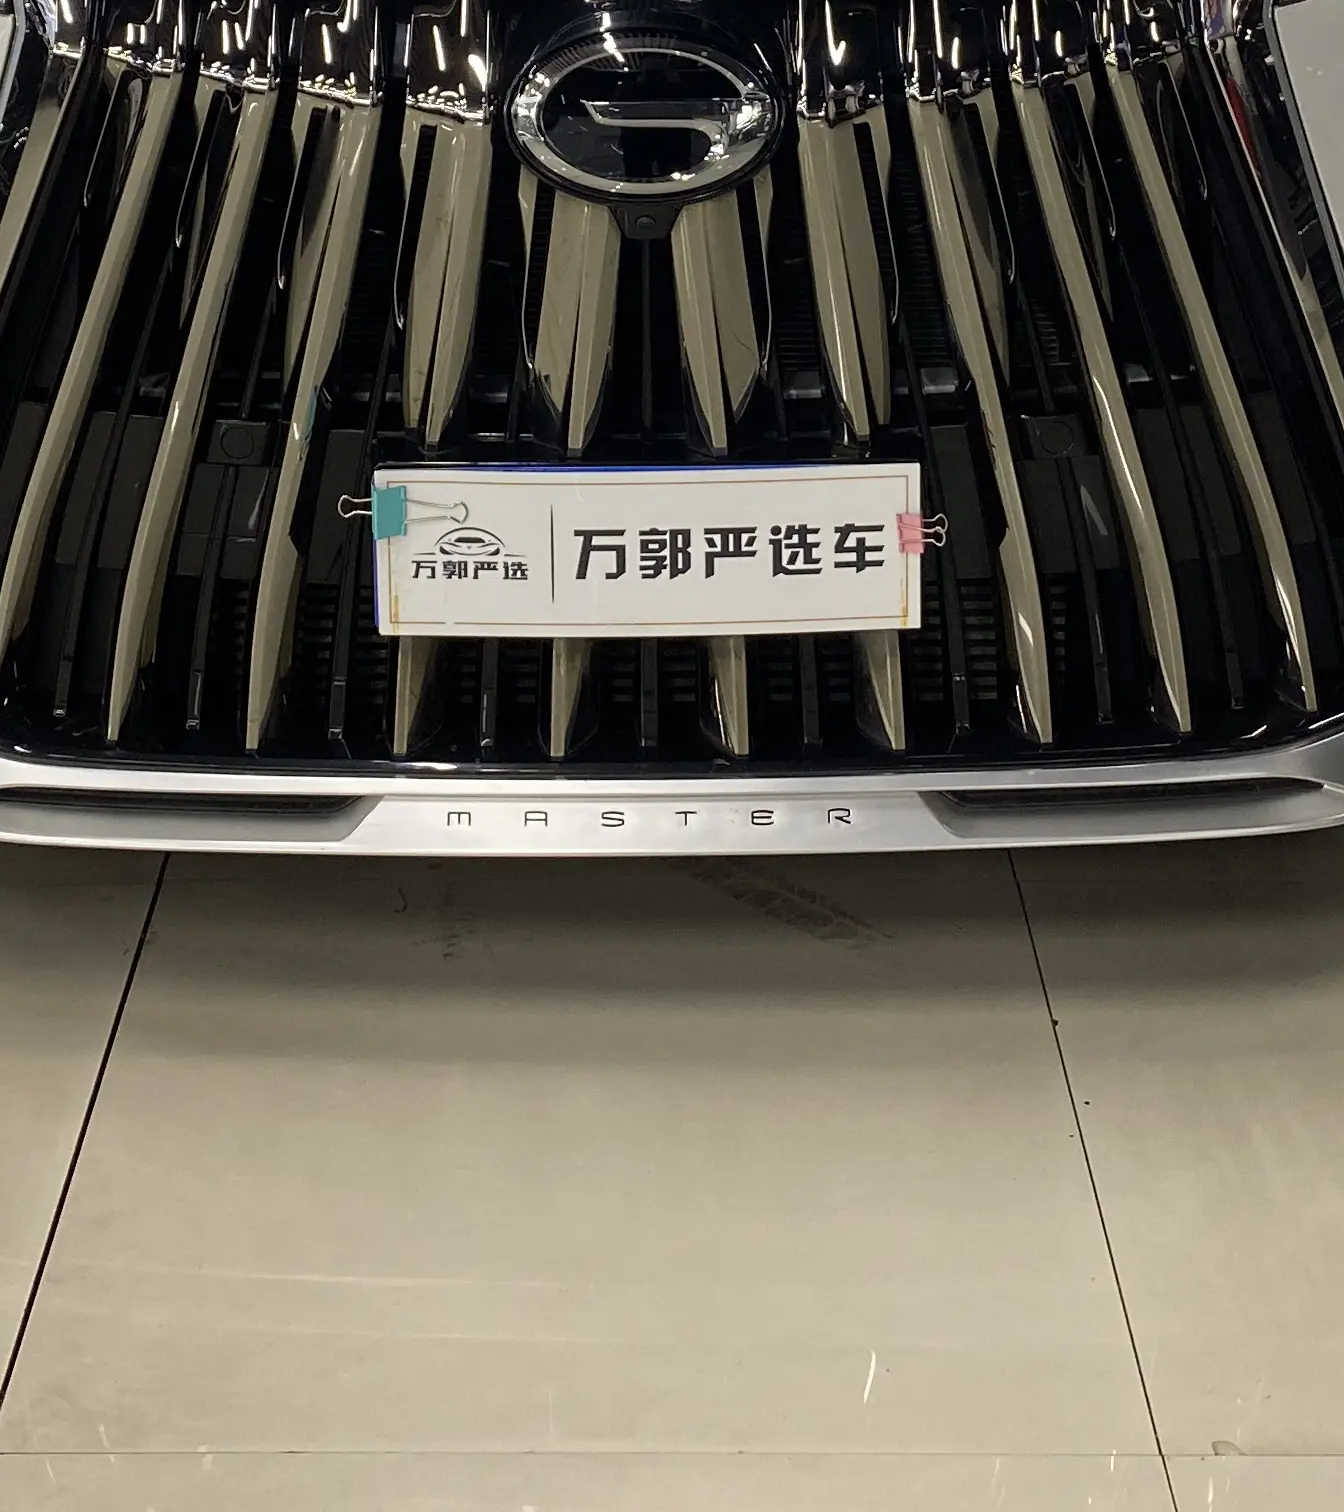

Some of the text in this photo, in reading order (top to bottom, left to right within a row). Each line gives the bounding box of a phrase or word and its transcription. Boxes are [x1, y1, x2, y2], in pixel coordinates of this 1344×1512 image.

[573, 523, 886, 581] 万郭严选车
[411, 559, 529, 581] 万郭严选
[447, 808, 852, 827] MASTER
